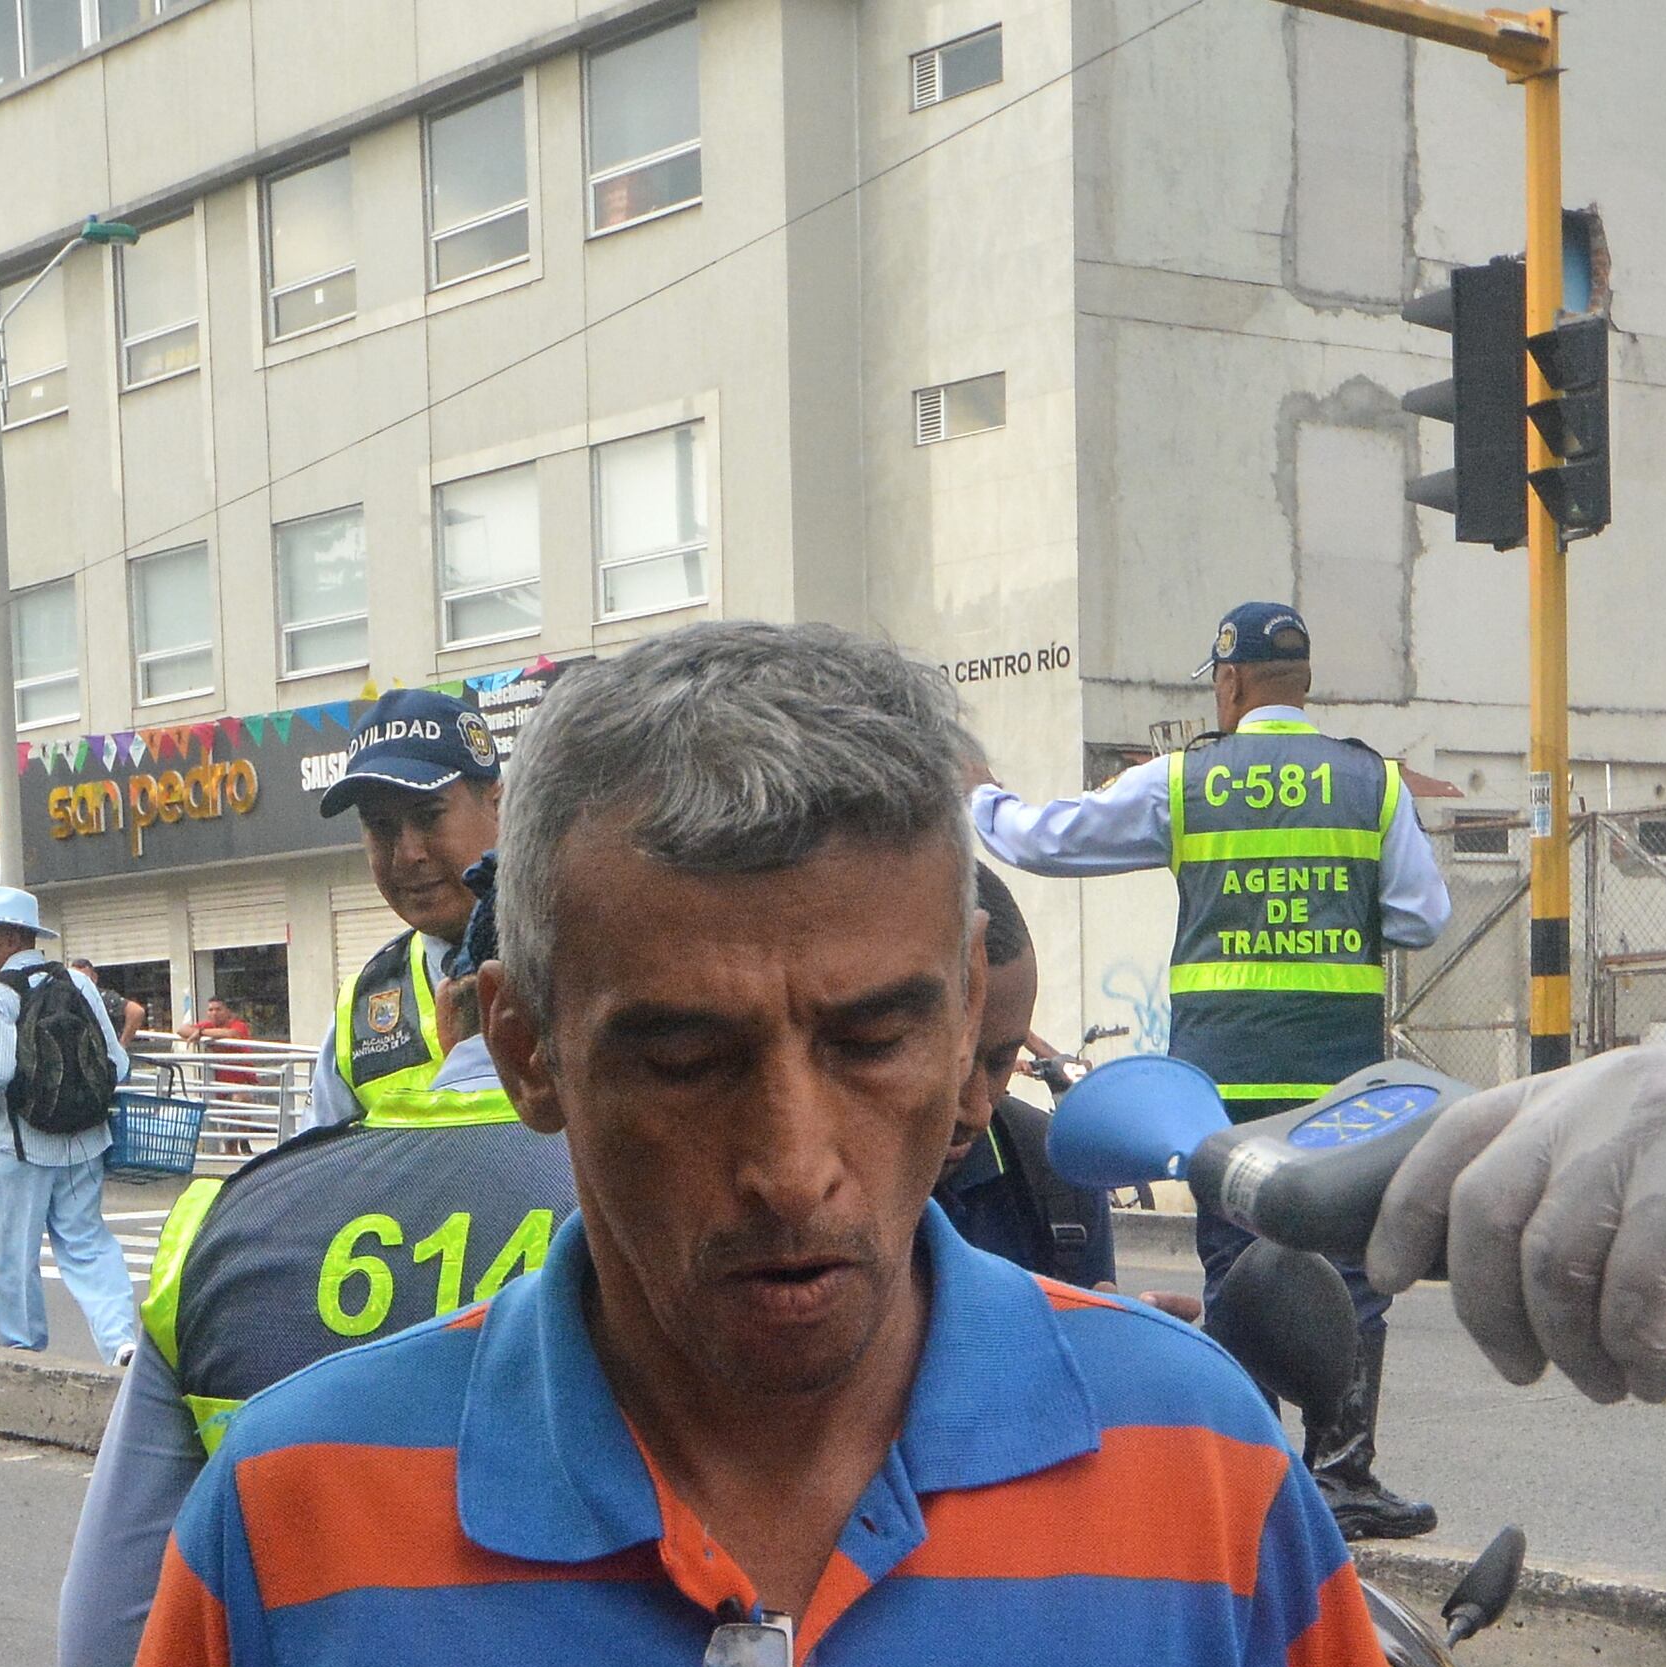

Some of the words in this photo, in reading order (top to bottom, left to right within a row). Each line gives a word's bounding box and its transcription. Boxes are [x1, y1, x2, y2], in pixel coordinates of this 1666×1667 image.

[955, 652, 1032, 683] CENTRO
[1037, 641, 1071, 672] RÍO
[348, 719, 441, 760] OVILIDAD
[48, 779, 123, 840] san
[129, 749, 258, 858] pedro
[1205, 763, 1331, 808] C-581
[1223, 867, 1349, 894] AGENTE
[1267, 898, 1309, 924] DE
[1218, 929, 1362, 955] TRANSITO
